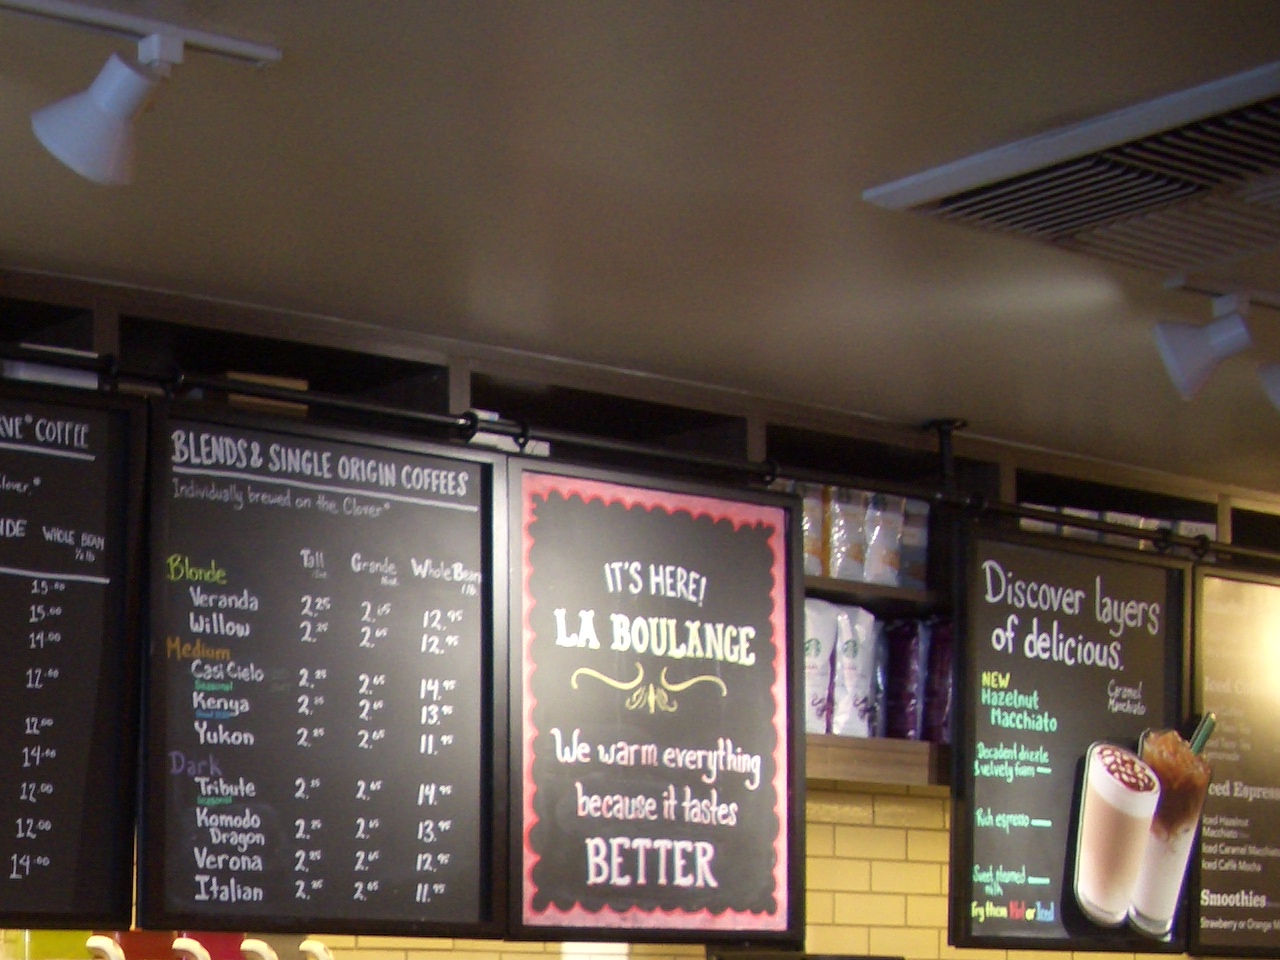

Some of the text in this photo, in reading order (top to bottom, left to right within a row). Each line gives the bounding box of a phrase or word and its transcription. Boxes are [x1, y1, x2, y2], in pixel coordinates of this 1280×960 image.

[35, 418, 89, 449] COFFEE
[171, 429, 469, 497] BLENDS & SINGLE ORIGIN COFFEES
[172, 477, 244, 511] Individually
[247, 485, 291, 508] brewed
[295, 496, 312, 509] on
[317, 496, 338, 514] the
[42, 525, 75, 546] WHOLE
[81, 532, 105, 550] BEAN
[166, 553, 227, 585] Blonde
[300, 547, 324, 568] Tall
[351, 552, 397, 575] Grande
[410, 557, 452, 582] Whole
[451, 562, 481, 583] Bean
[603, 561, 707, 607] IT'S HERE!
[189, 585, 259, 612] Veranda
[981, 559, 1160, 638] Discover layers
[189, 611, 250, 638] Willow
[554, 607, 756, 666] LA BOULANGE
[166, 636, 231, 661] Medium
[991, 613, 1124, 671] of delicious.
[191, 658, 265, 683] Casi Cielo
[981, 671, 1011, 689] NEW
[192, 690, 250, 717] Kenya
[981, 687, 1040, 711] Hazelnut
[193, 720, 255, 746] Yukon
[990, 707, 1058, 733] Macchiato
[170, 750, 223, 776] Dark
[550, 727, 761, 790] We warm everything
[194, 776, 256, 797] Tribute
[1208, 780, 1231, 797] ced
[575, 781, 738, 826] because it tastes
[195, 806, 261, 829] Komodo
[209, 827, 265, 853] Dragon
[193, 846, 263, 872] Verona
[585, 836, 718, 889] BETTER
[194, 874, 264, 903] Italian
[1200, 888, 1267, 909] Smoothies
